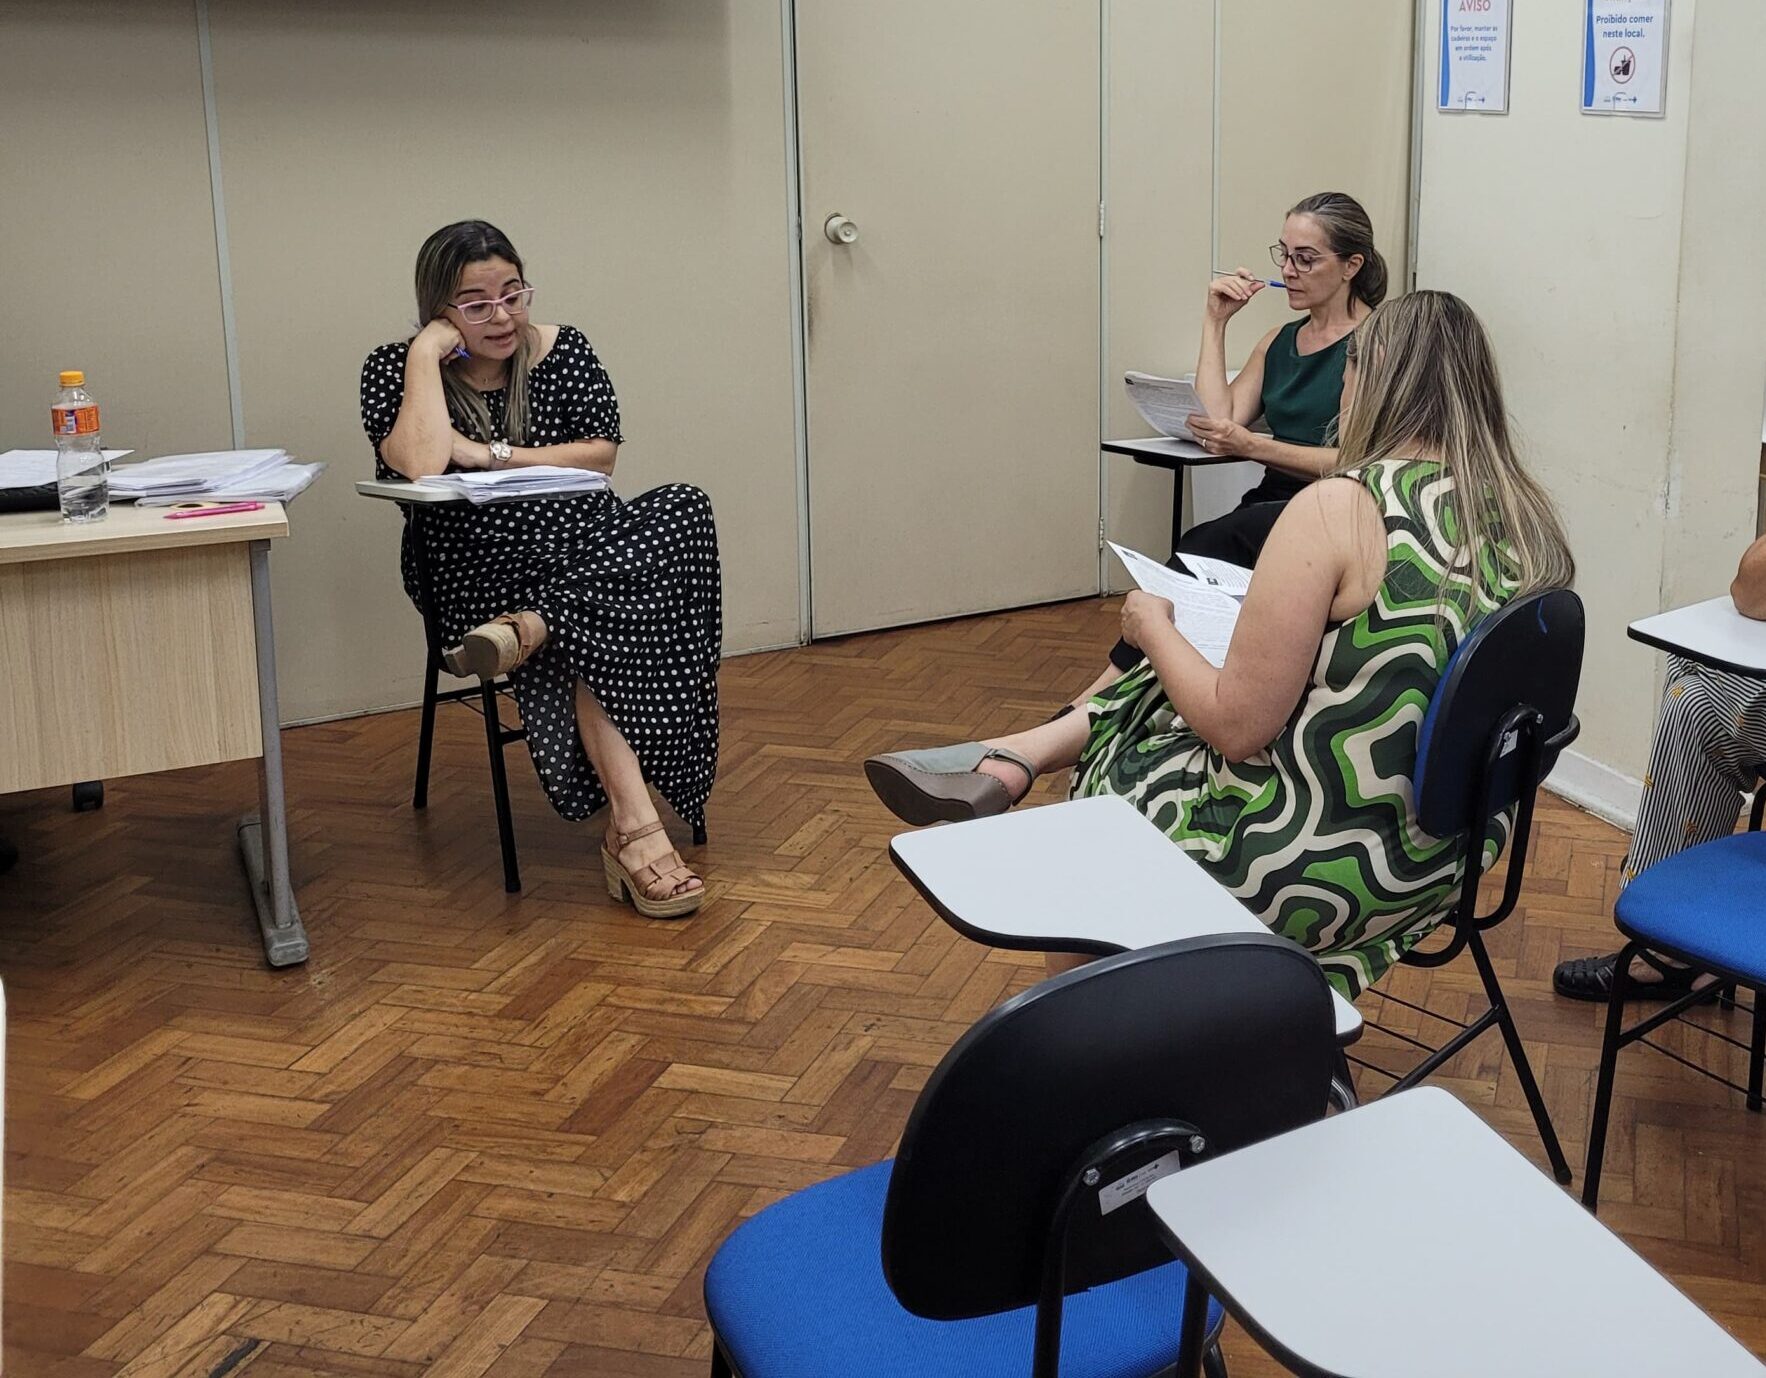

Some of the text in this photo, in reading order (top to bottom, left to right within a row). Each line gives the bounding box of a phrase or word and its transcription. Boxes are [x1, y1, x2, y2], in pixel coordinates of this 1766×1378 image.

[1459, 0, 1491, 11] AVISO
[1596, 14, 1654, 24] Proibido comer
[1602, 28, 1645, 38] neste local.
